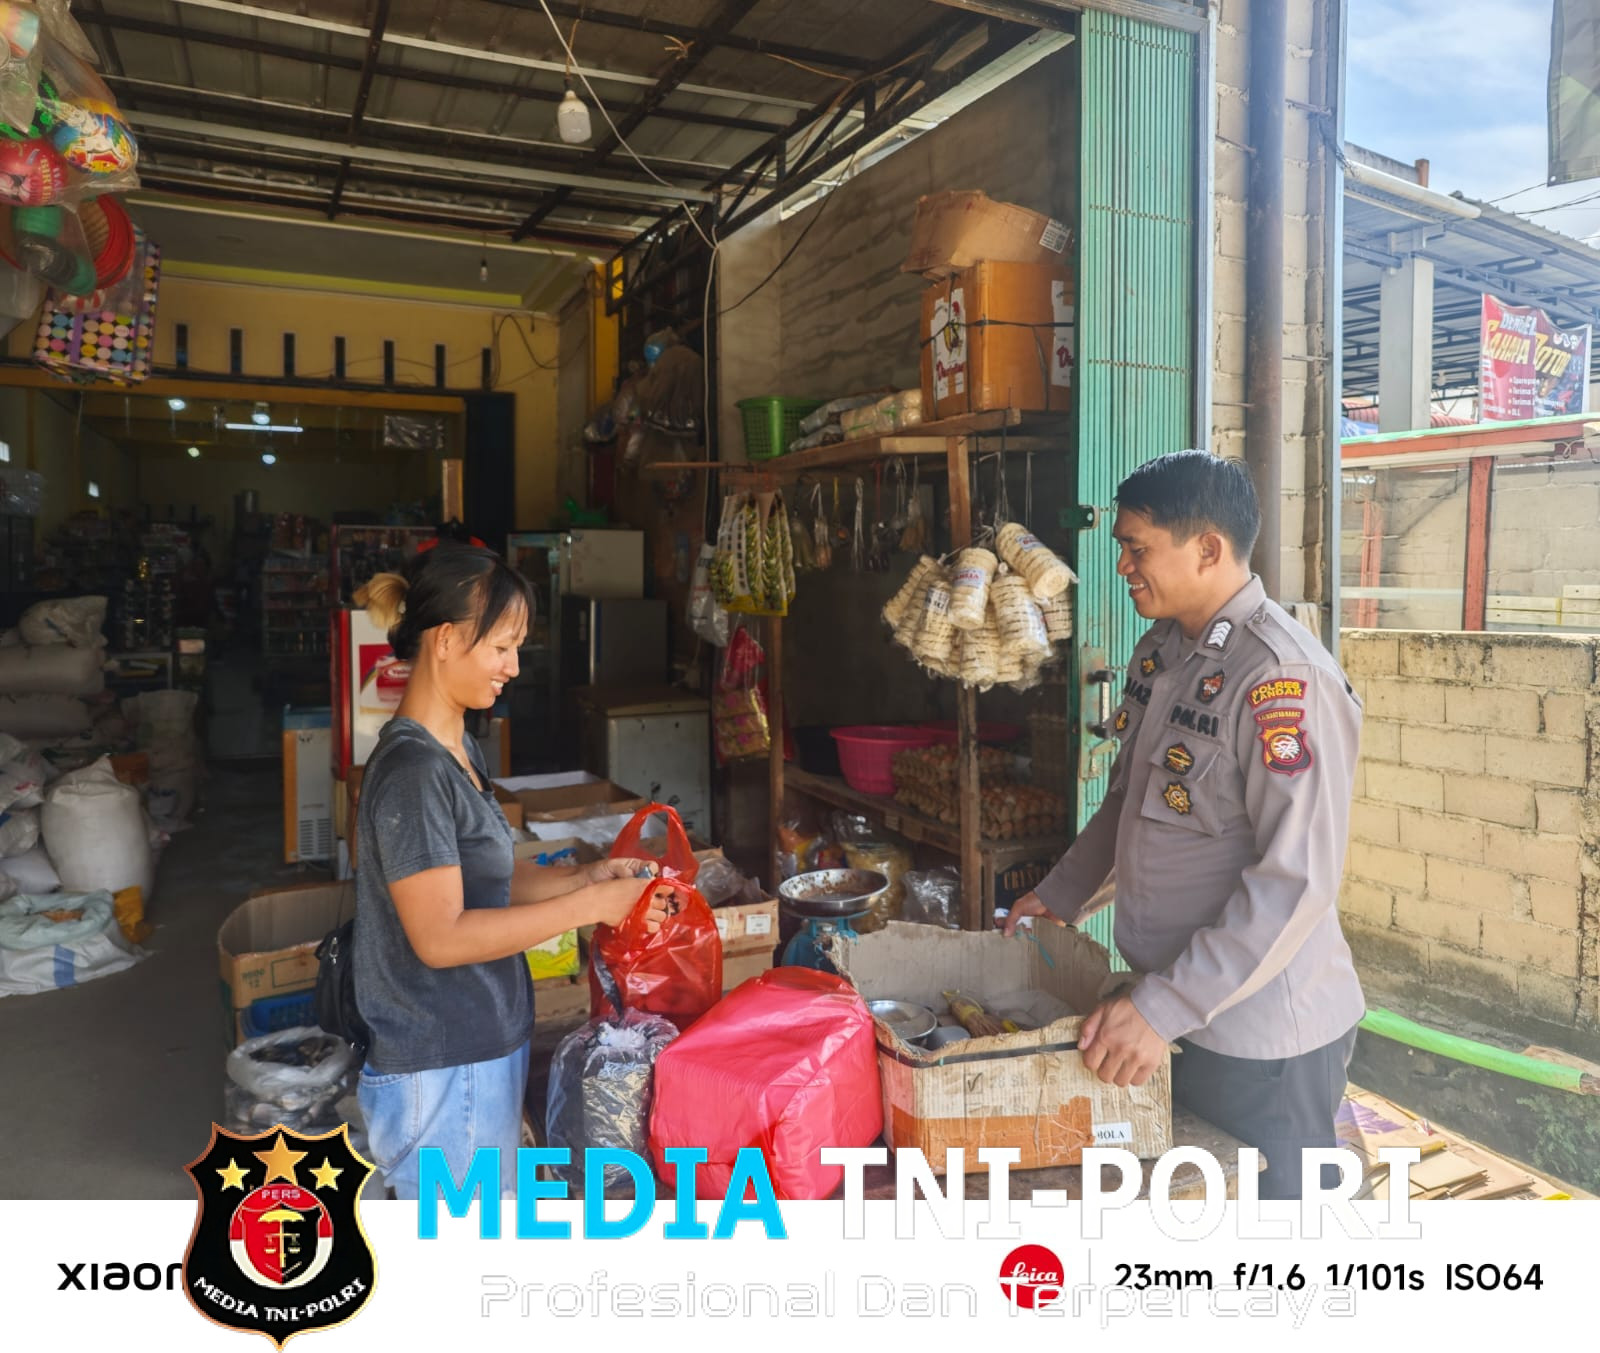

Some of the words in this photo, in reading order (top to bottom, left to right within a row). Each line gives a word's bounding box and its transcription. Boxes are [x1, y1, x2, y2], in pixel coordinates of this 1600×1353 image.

[1251, 680, 1300, 699] POLRES
[1252, 688, 1302, 705] LANDAK
[1170, 705, 1218, 737] POLRI
